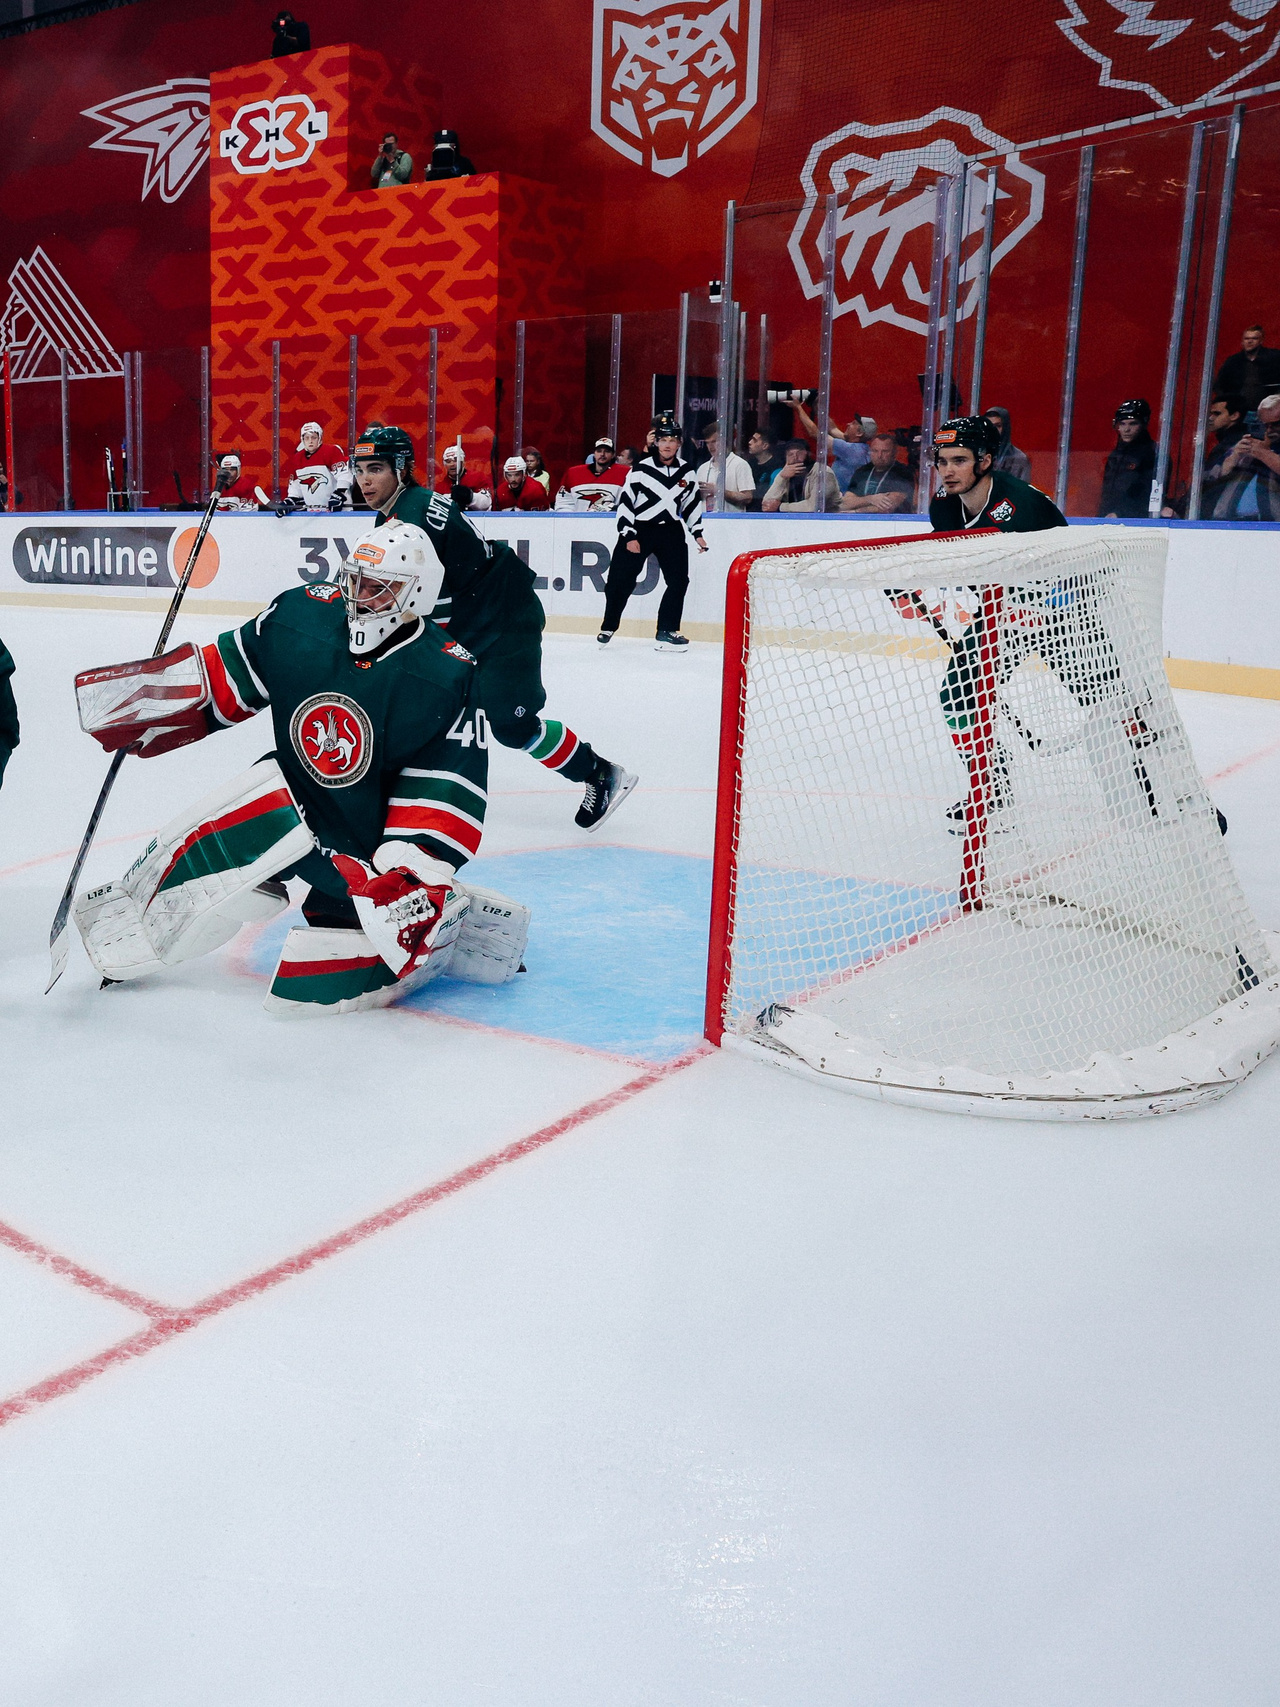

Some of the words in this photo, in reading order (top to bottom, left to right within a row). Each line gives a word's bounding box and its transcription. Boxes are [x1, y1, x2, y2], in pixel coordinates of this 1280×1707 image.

[25, 537, 158, 577] Winline
[445, 706, 489, 750] 40
[87, 885, 112, 901] L12.2
[437, 904, 470, 936] RUE
[483, 904, 512, 919] L12.2
